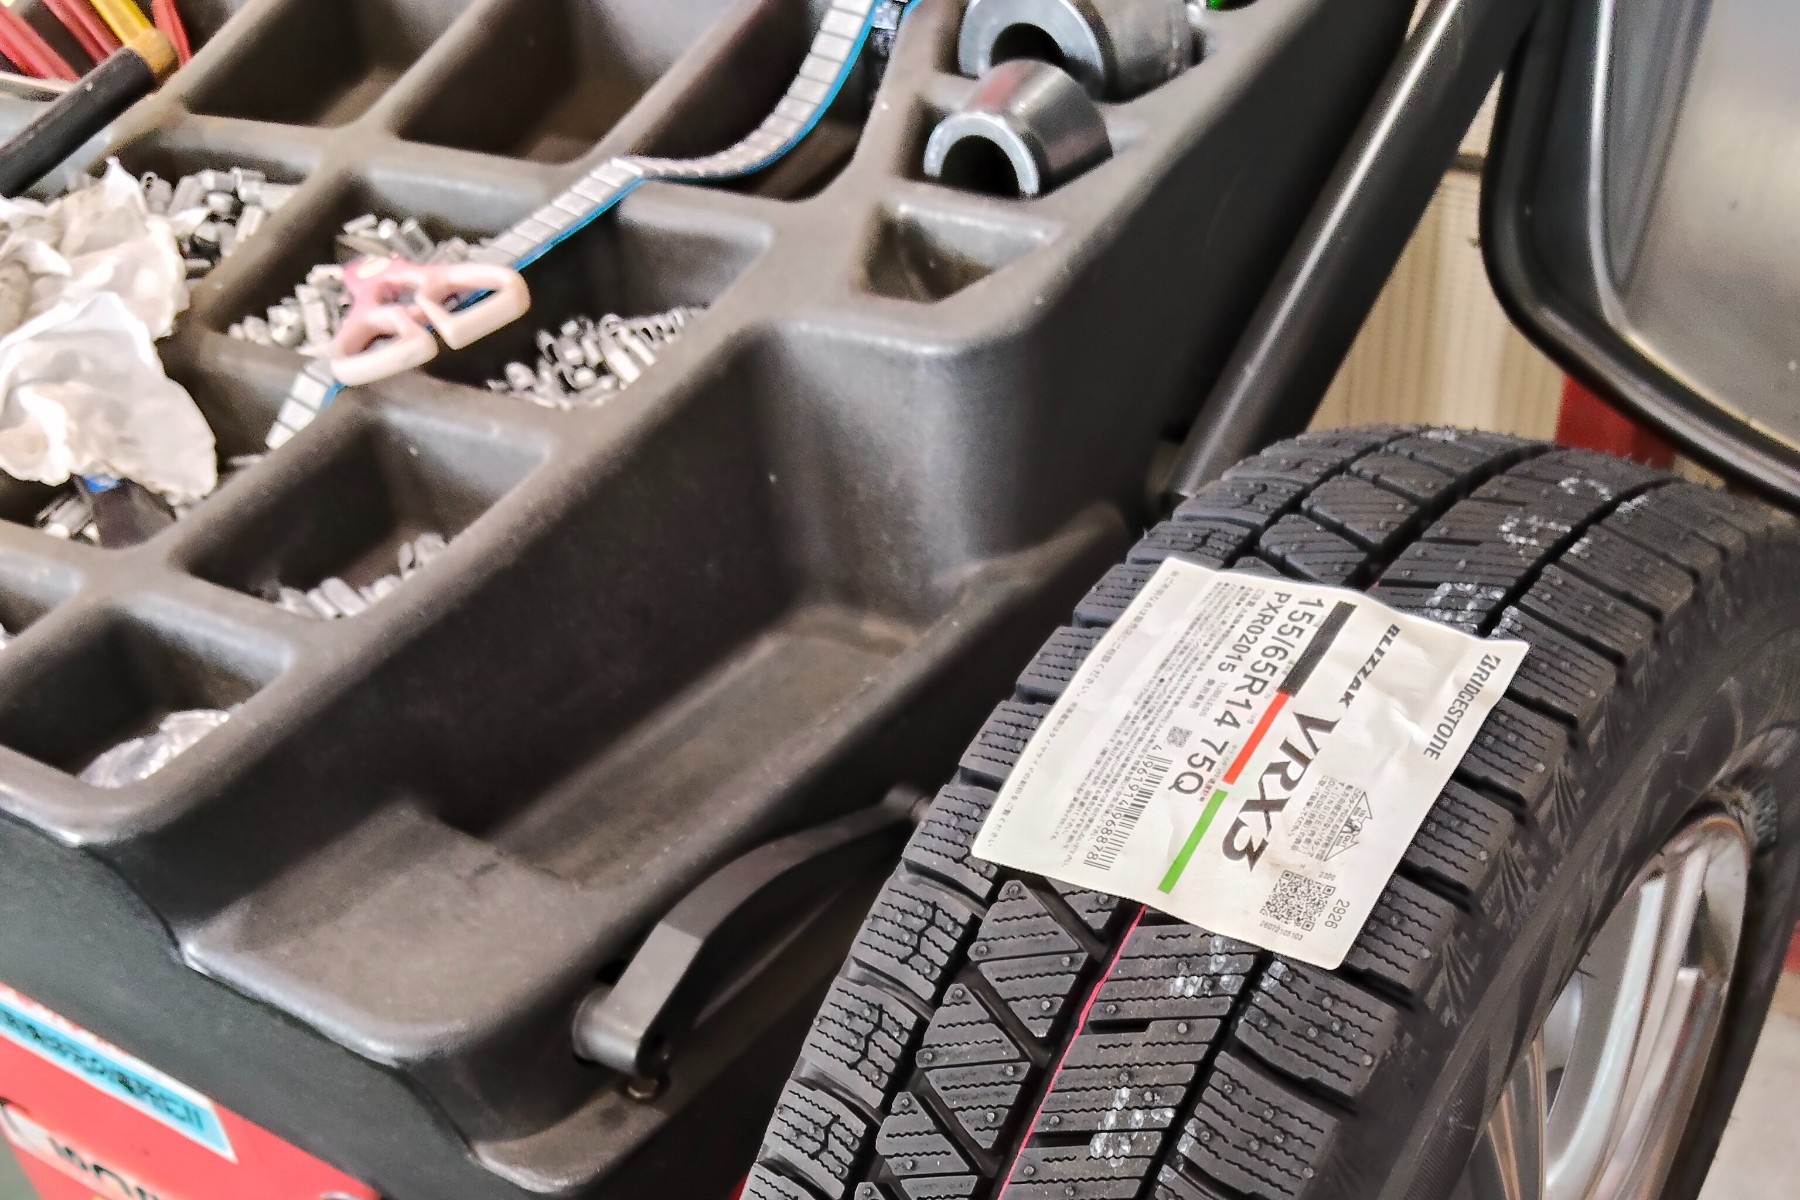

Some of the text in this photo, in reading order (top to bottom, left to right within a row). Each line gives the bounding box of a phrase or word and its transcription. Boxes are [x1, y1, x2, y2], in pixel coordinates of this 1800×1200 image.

[1210, 594, 1323, 731] 155/65R14
[1215, 590, 1292, 674] PXR02015
[1197, 680, 1227, 717] TUBELESS
[1421, 653, 1502, 760] BRIDGESTONE
[1166, 733, 1230, 797] 75Q
[1221, 623, 1402, 872] BLIZZAK VRX3
[1085, 743, 1162, 861] 4 961914 968878
[1338, 835, 1350, 847] OUT
[1322, 898, 1351, 929] 2926
